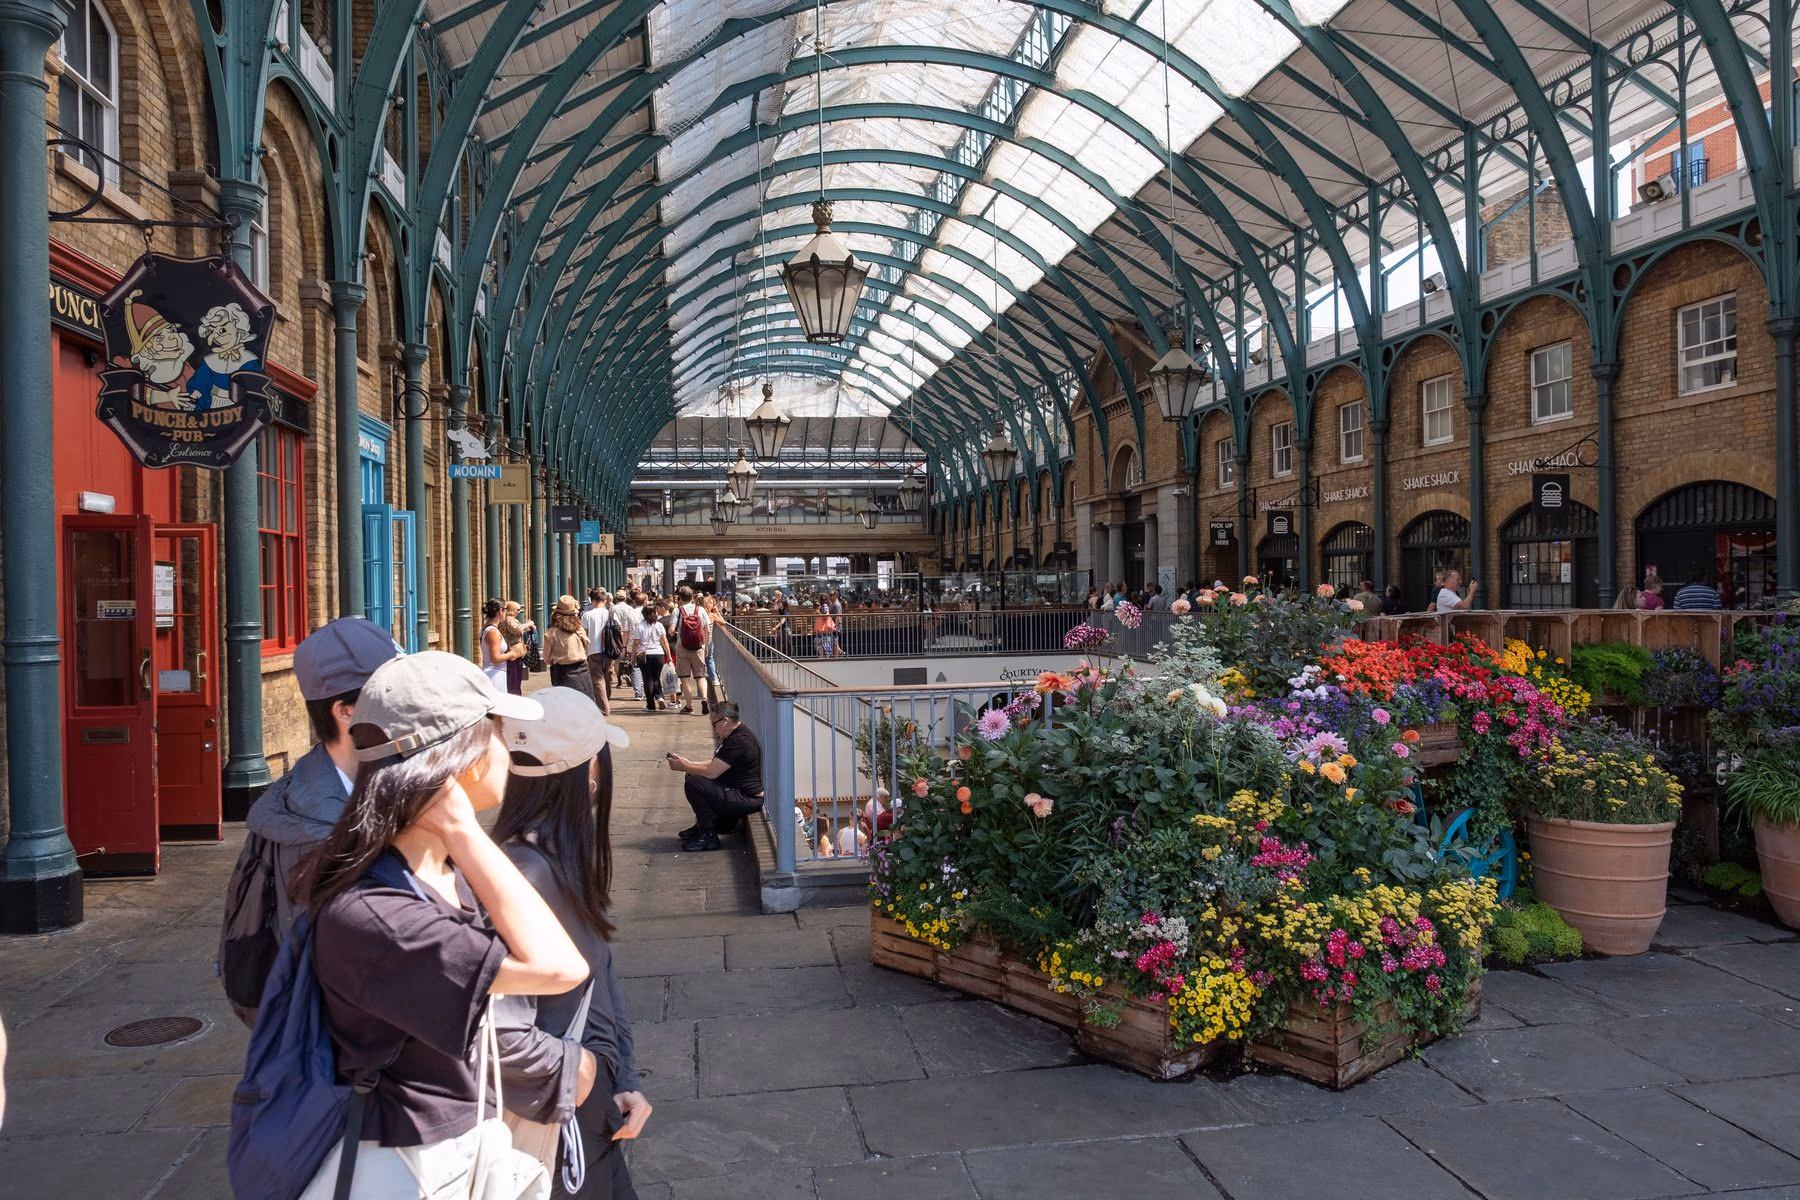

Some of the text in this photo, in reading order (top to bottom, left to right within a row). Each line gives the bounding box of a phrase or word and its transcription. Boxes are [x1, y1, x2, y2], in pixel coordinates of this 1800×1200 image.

[131, 400, 187, 429] PUNCH
[199, 405, 243, 428] JUDY
[172, 430, 204, 442] PUB
[169, 442, 212, 457] Entrance
[1508, 450, 1583, 476] SHAKE SHACK
[454, 465, 496, 478] MOOMIN
[1403, 470, 1460, 491] SHAKE SHACK
[1323, 486, 1369, 503] SHAKE SHACK
[999, 668, 1057, 680] COURTYA
